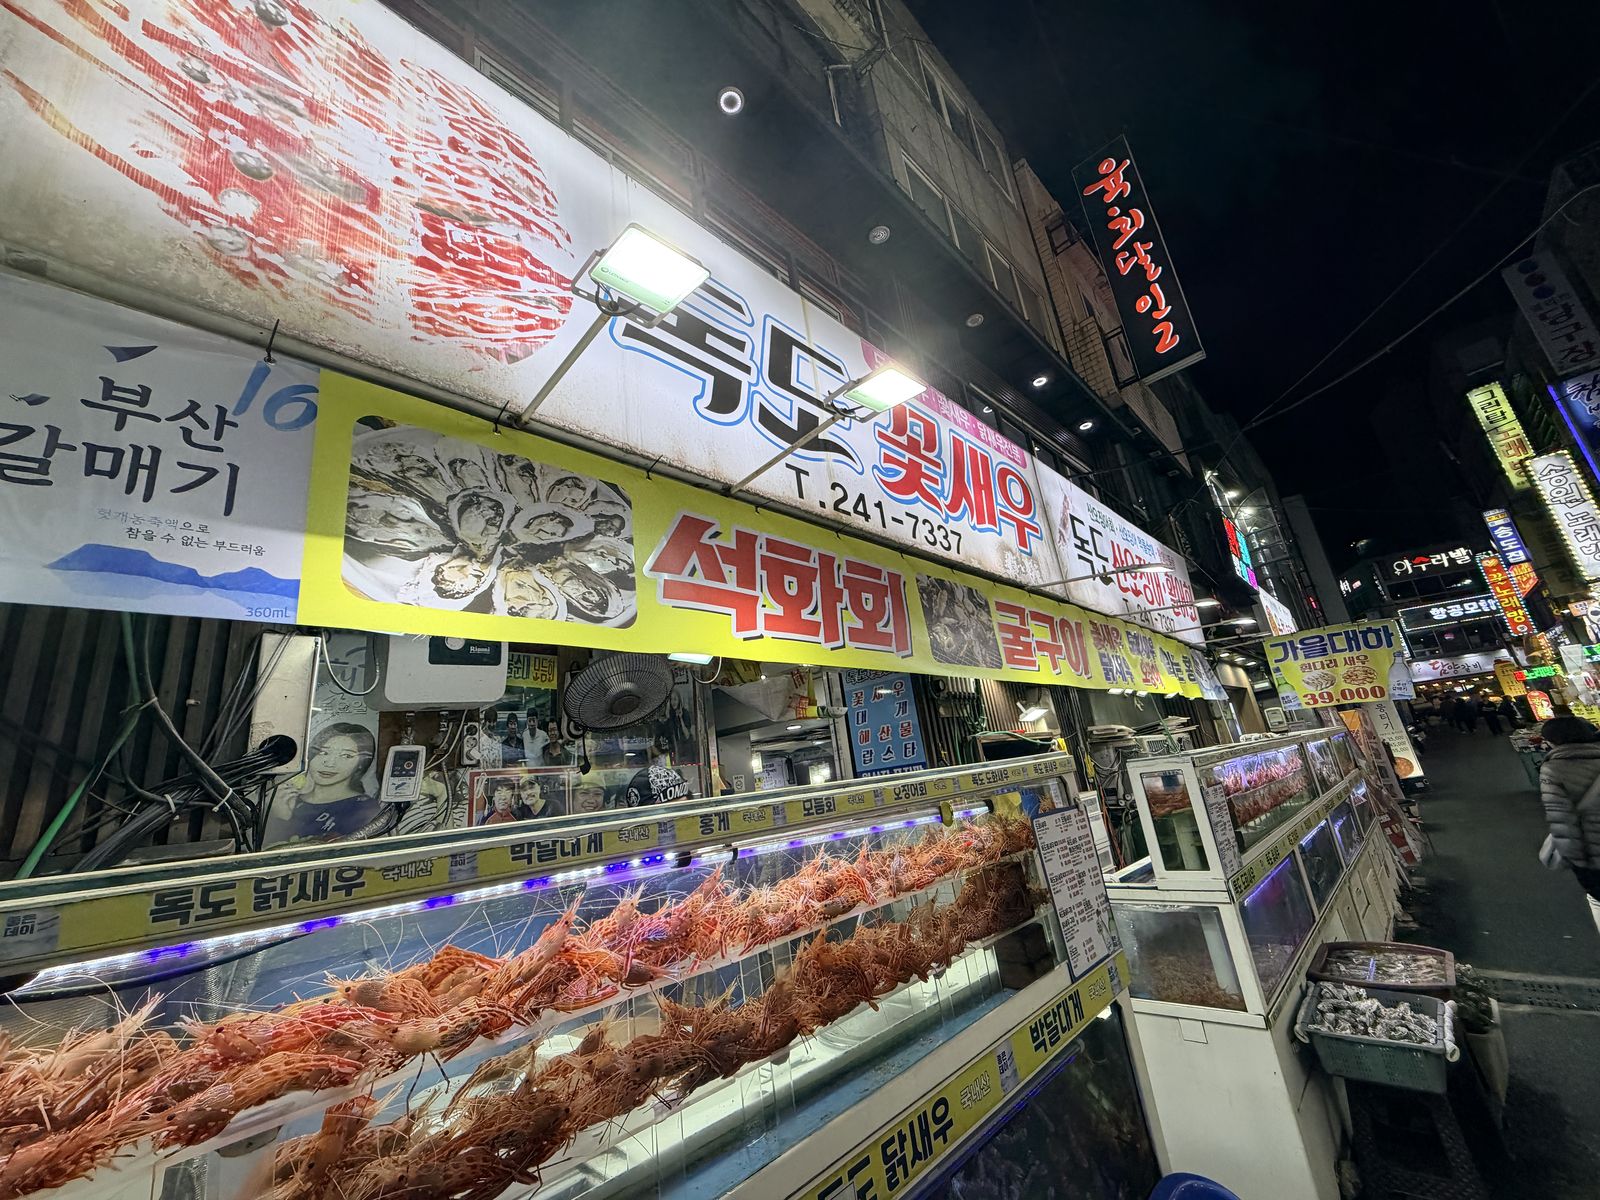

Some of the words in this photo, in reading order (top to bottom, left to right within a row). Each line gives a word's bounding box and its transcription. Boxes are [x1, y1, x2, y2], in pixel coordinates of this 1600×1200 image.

[610, 282, 862, 472] 독도
[80, 376, 239, 453] 부산
[0, 422, 240, 517] 갈매기
[876, 402, 1042, 553] 꽃새우
[125, 527, 157, 542] 참을
[160, 533, 176, 543] 수
[181, 536, 208, 549] 없는
[213, 541, 266, 556] 부드러움
[1069, 513, 1115, 586] 독도
[643, 513, 908, 656] 석화회
[995, 600, 1093, 680] 굴구이
[1269, 625, 1395, 664] 가을대하
[1303, 685, 1386, 706] 39,000
[893, 782, 927, 801] 오징어회
[618, 827, 650, 844] 국내산
[150, 882, 238, 926] 독도
[252, 867, 366, 913] 닭새우
[382, 859, 434, 882] 국내산
[1029, 989, 1085, 1053] 박달대게
[881, 1096, 953, 1192] 닭새우
[960, 1070, 991, 1110] 국내산
